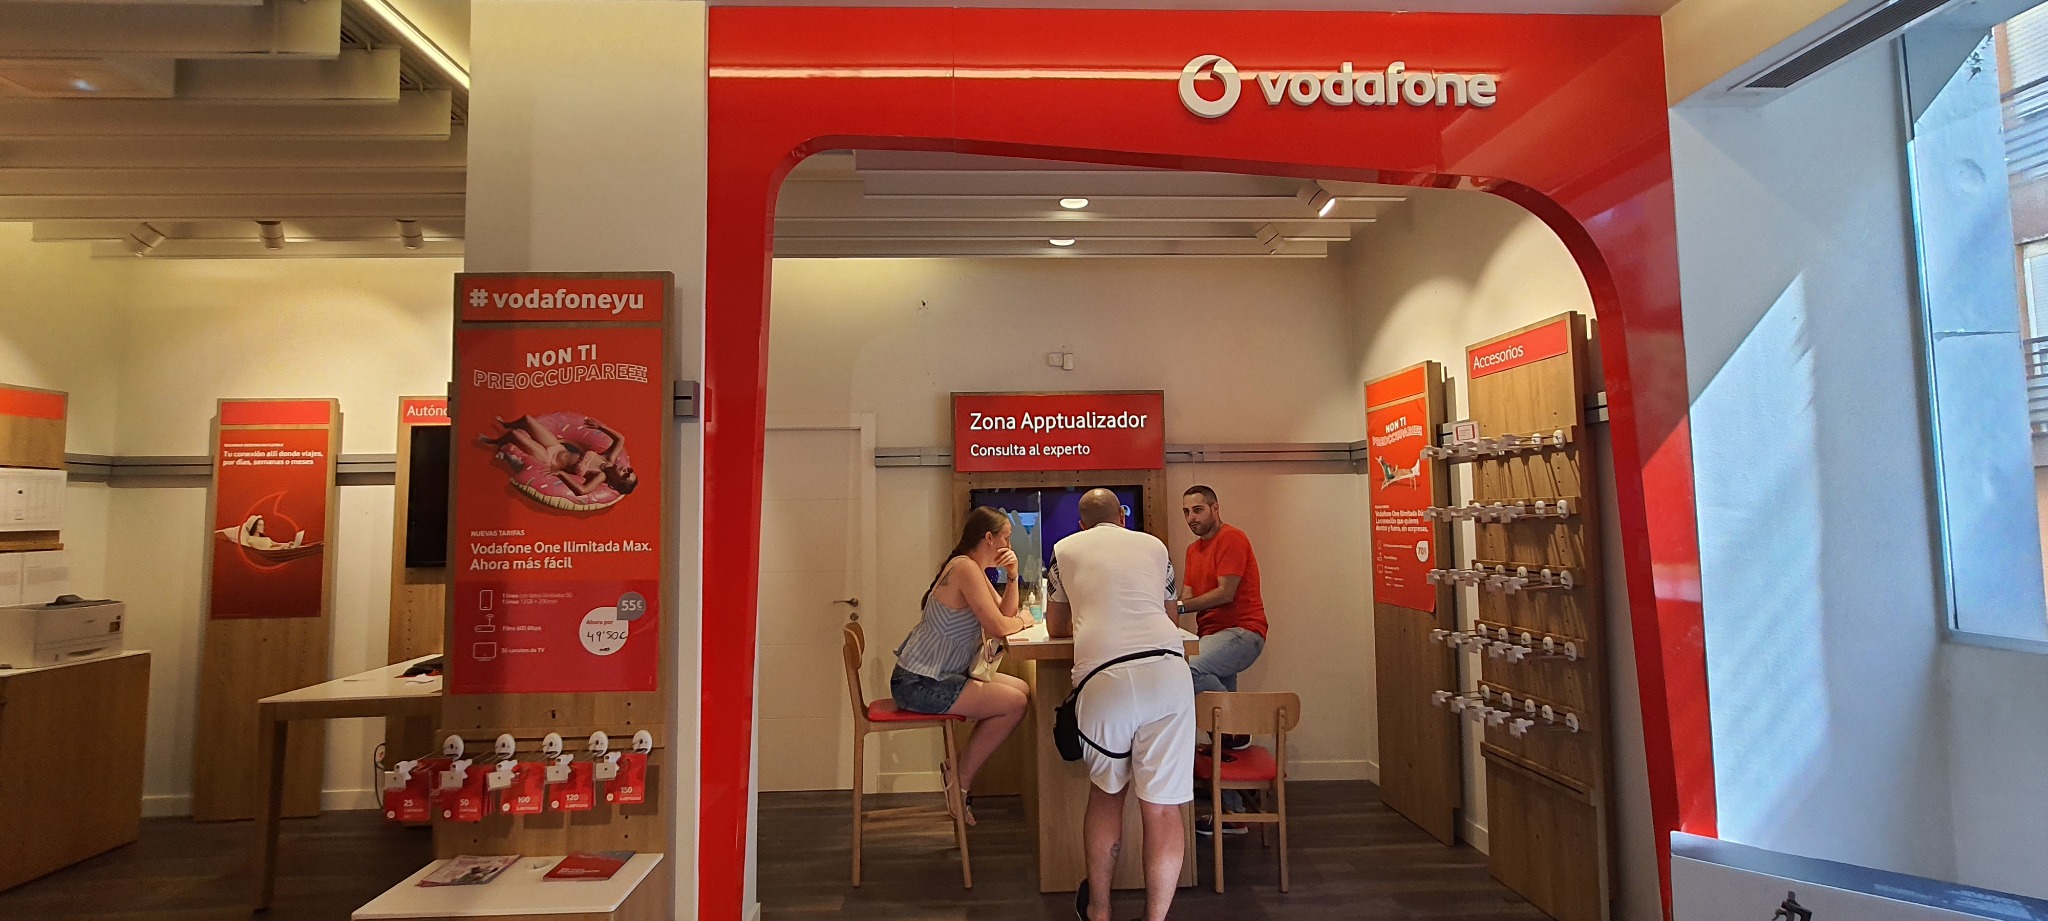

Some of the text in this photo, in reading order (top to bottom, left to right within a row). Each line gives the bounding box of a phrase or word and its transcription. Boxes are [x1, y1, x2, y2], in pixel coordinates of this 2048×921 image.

[1255, 61, 1496, 107] vodafone
[526, 343, 597, 368] NON TI
[1473, 344, 1524, 371] Accesorios
[970, 410, 1148, 434] Zona Apptualizador
[1386, 416, 1406, 433] NON TI
[970, 442, 1091, 458] Consulta al experto
[471, 540, 652, 555] Vodafone One Ilimitada Max.
[470, 556, 573, 571] Ahora más fácil
[621, 600, 643, 611] 55€
